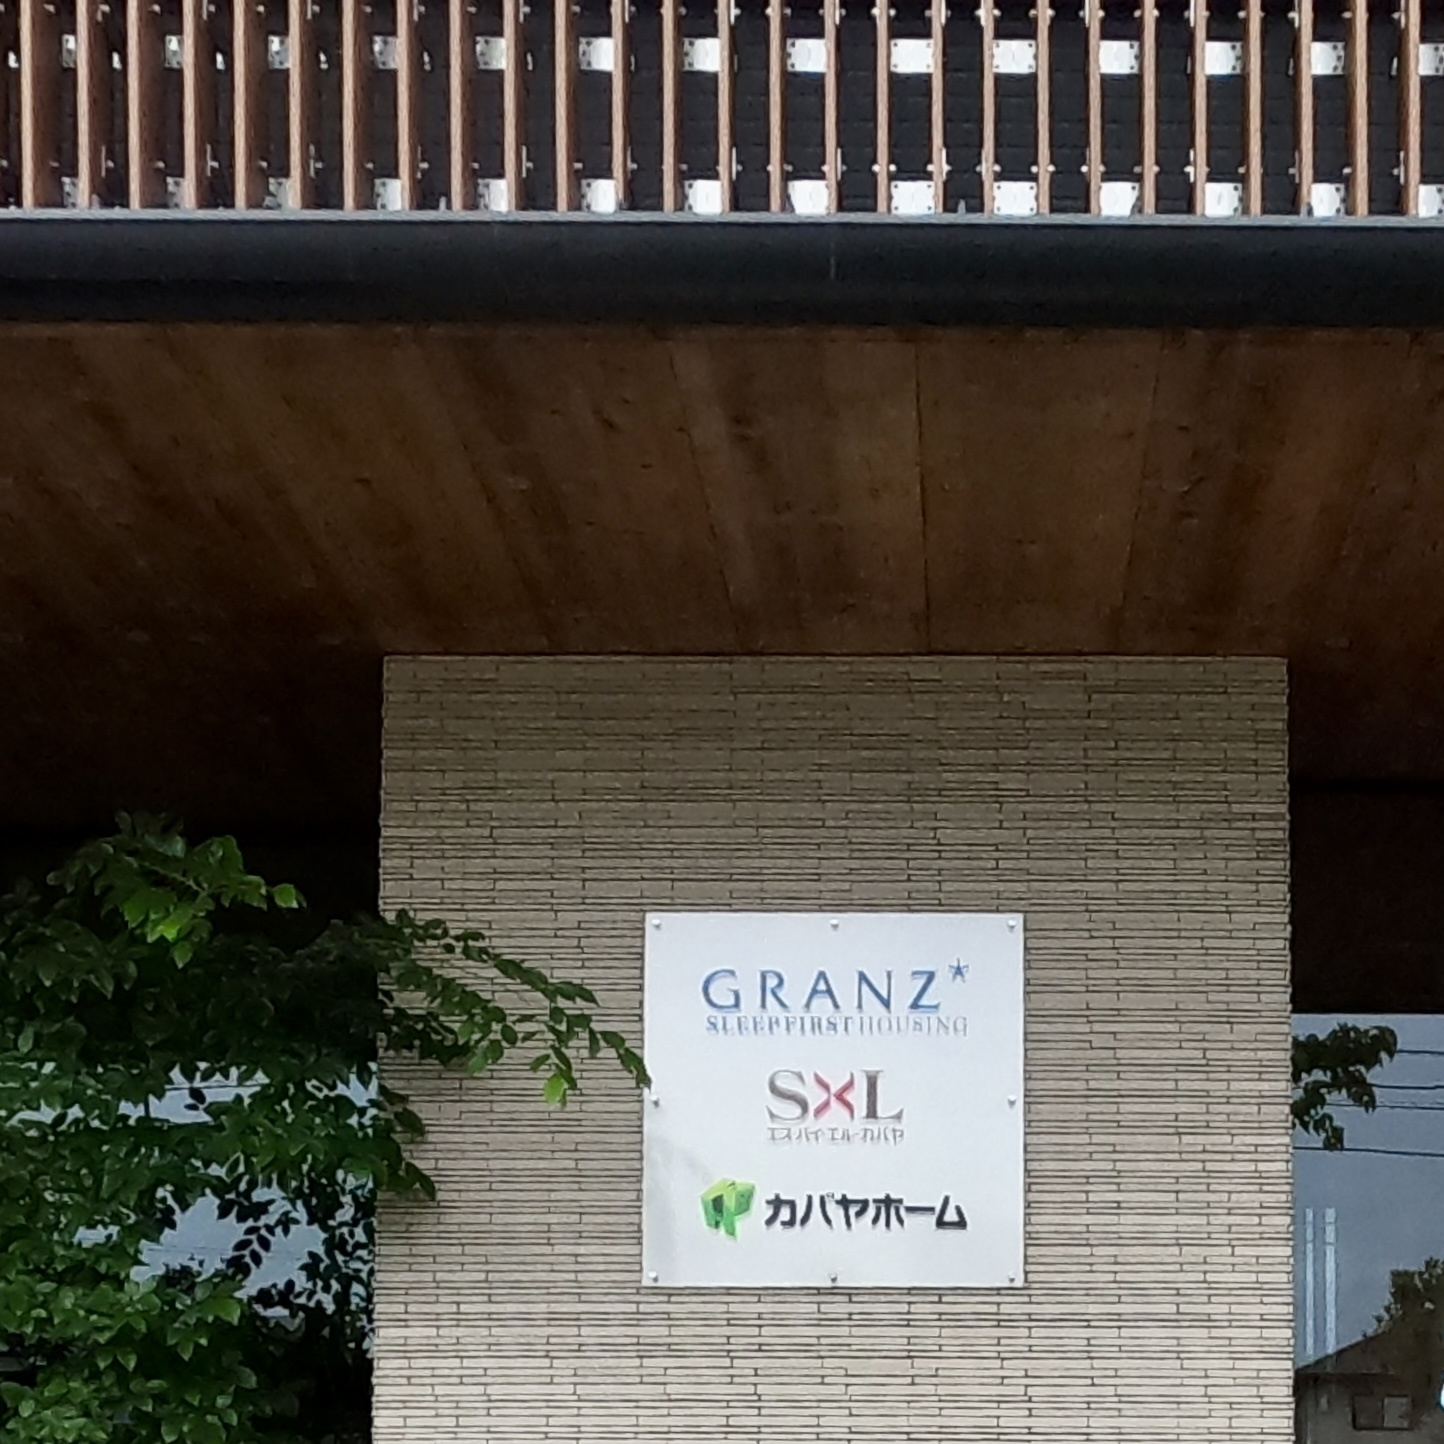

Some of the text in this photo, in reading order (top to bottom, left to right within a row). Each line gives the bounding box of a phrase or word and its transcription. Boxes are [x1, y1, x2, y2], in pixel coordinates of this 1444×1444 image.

[702, 968, 940, 1012] GRANZ
[764, 1193, 969, 1230] カバヤホーム
